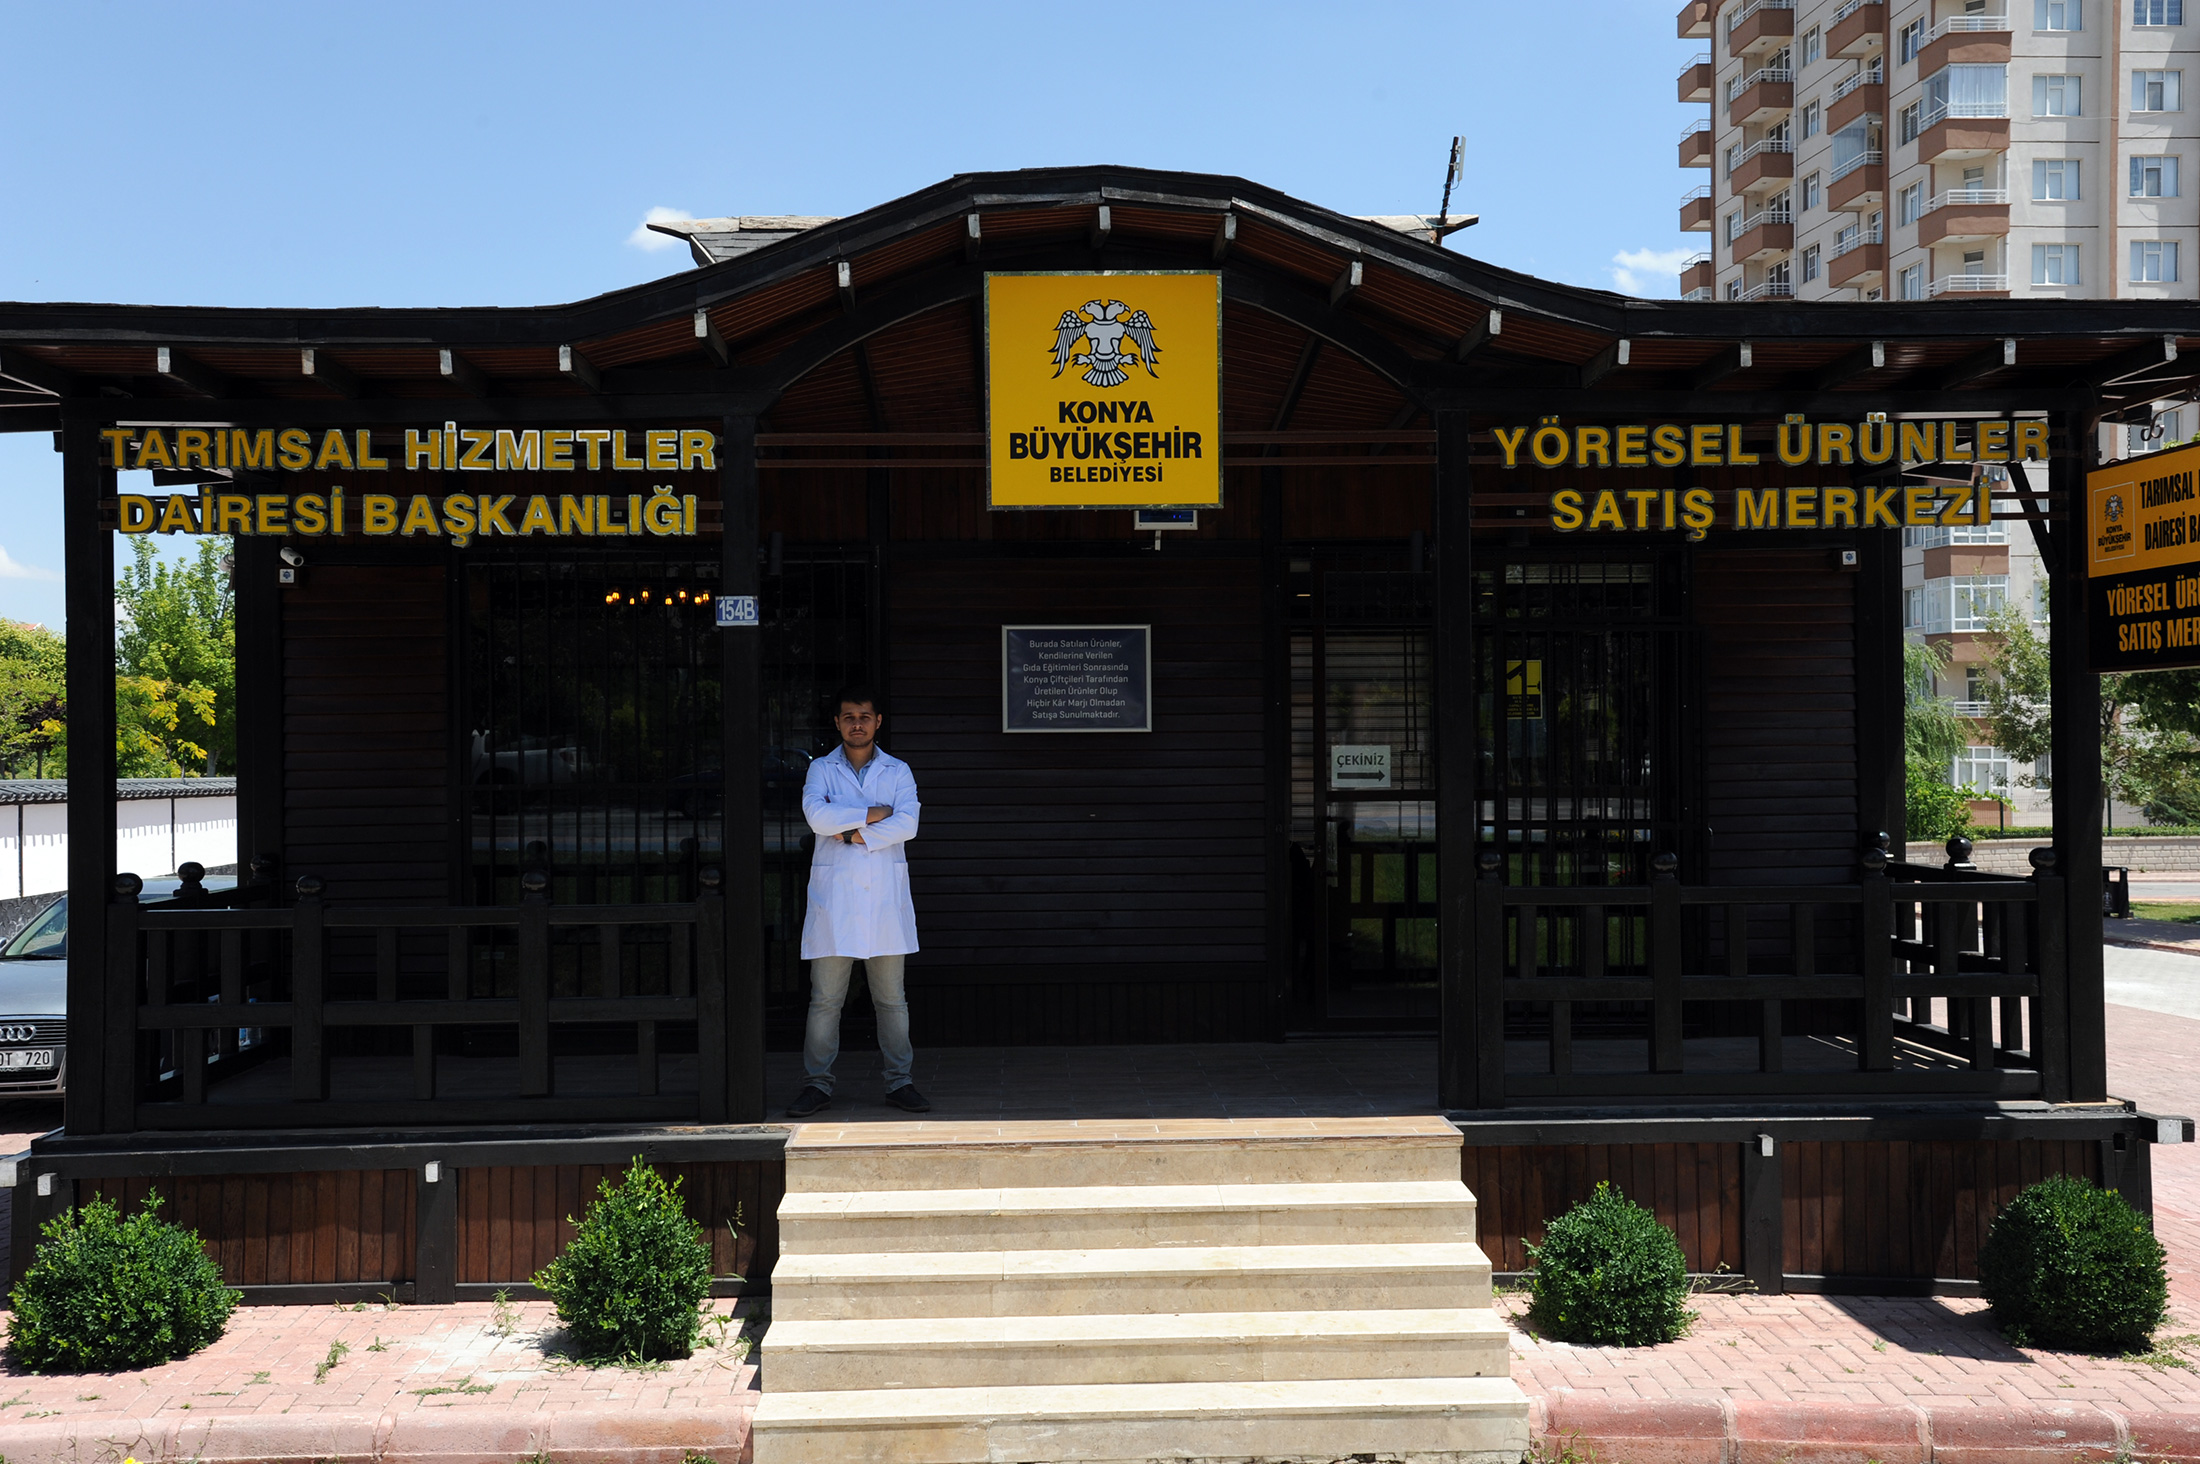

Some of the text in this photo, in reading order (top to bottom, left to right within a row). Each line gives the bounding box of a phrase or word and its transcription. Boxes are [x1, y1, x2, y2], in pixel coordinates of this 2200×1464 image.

[1058, 400, 1155, 424] KONYA
[101, 421, 716, 470] TARIMSAL HİZMETLER
[1009, 425, 1203, 464] BÜYÜKŞEHİR
[1492, 412, 2051, 467] YÖRESEL ÜRÜNLER
[1050, 461, 1163, 483] BELEDİYESİ
[2139, 470, 2195, 509] TARIMSAL
[118, 485, 697, 547] DAİRESİ BAŞKANLIĞI
[1551, 475, 1992, 541] SATIŞ MERKEZİ
[2144, 511, 2187, 551] DAİRESİ
[718, 599, 756, 620] 154B
[2106, 583, 2171, 617] YÖRESEL
[1029, 637, 1122, 649] Burada Satılan Ürünler,
[2118, 620, 2162, 654] SATIŞ
[1038, 651, 1113, 660] Kendilerine Verilen
[1022, 663, 1129, 674] Gıda Eğitimleri Sonrasında
[1023, 674, 1129, 686] Konya Çiftçileri Tarafından
[1034, 685, 1118, 697] Üretilen Ürünler Olup
[1026, 698, 1051, 709] Hiçbir
[1067, 699, 1088, 709] Marjı
[1089, 698, 1126, 708] Olmadan
[1031, 710, 1121, 721] Satışa Sunulmaktadır.
[1337, 752, 1385, 769] ÇEKİNİZ
[25, 1051, 50, 1066] 720
